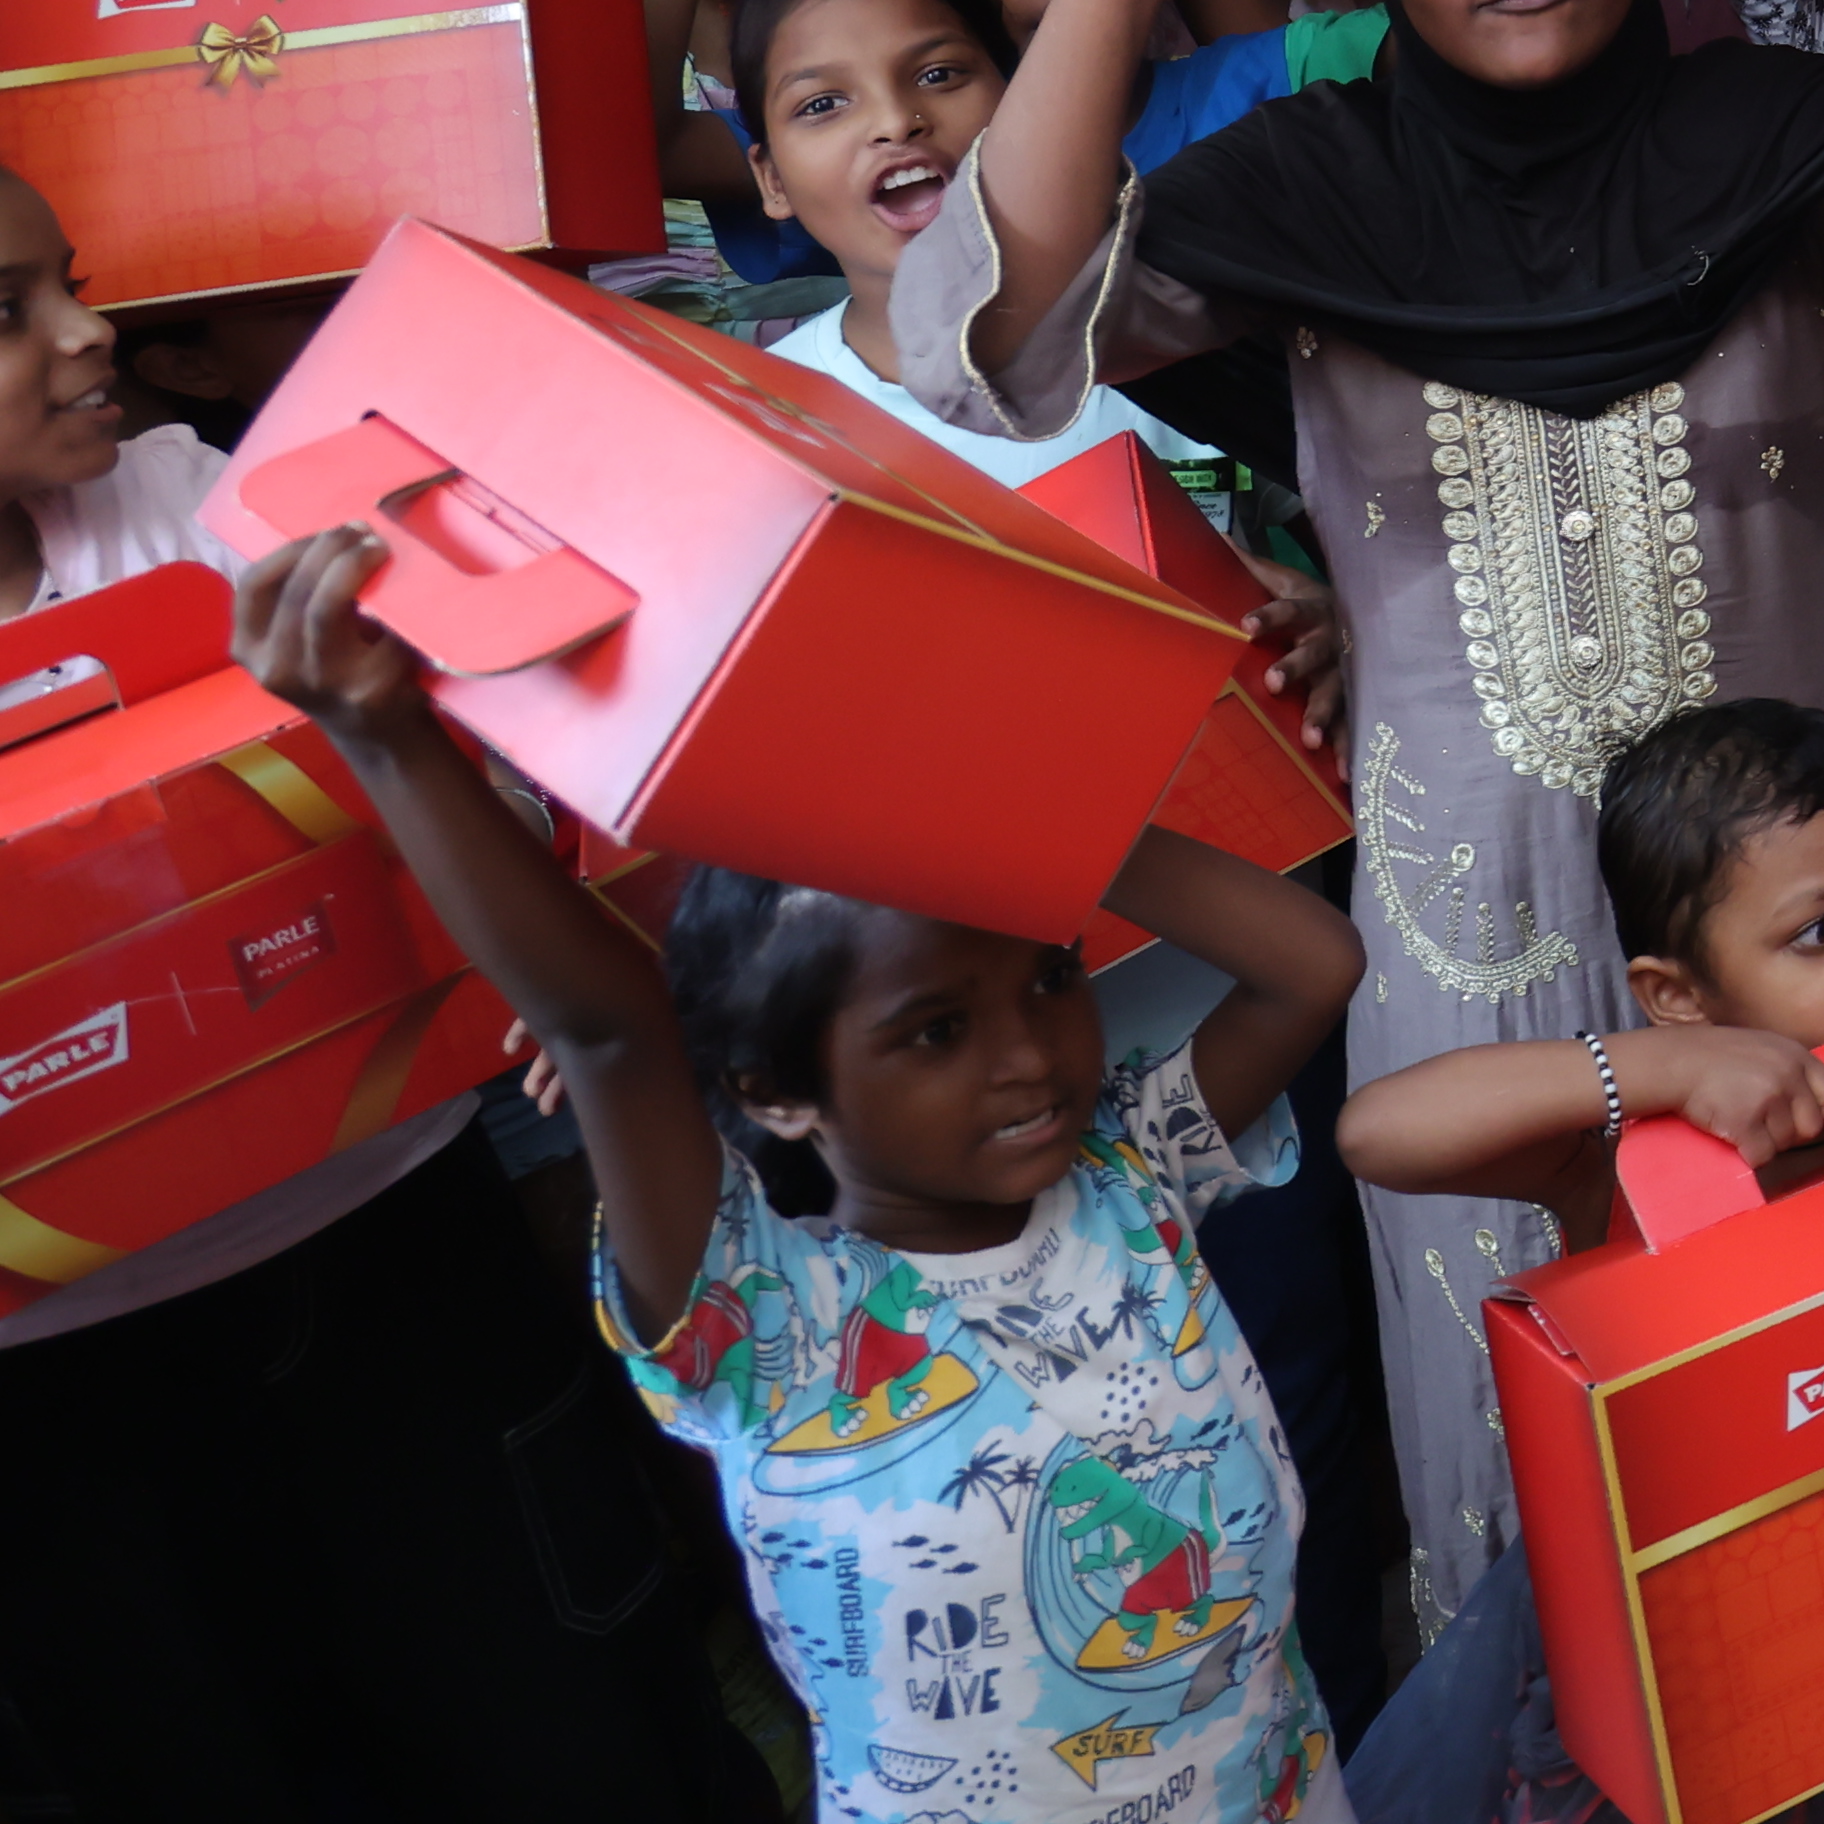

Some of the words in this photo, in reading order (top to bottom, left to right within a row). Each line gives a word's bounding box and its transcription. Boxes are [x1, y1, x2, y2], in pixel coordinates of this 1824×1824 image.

[243, 915, 320, 962] PARLE
[1, 1031, 109, 1092] PARLE
[835, 1547, 869, 1678] SURFBOARD
[905, 1594, 1009, 1661] RIDE
[938, 1650, 973, 1674] THE
[906, 1667, 1001, 1720] WAVE
[1073, 1730, 1144, 1759] SURF
